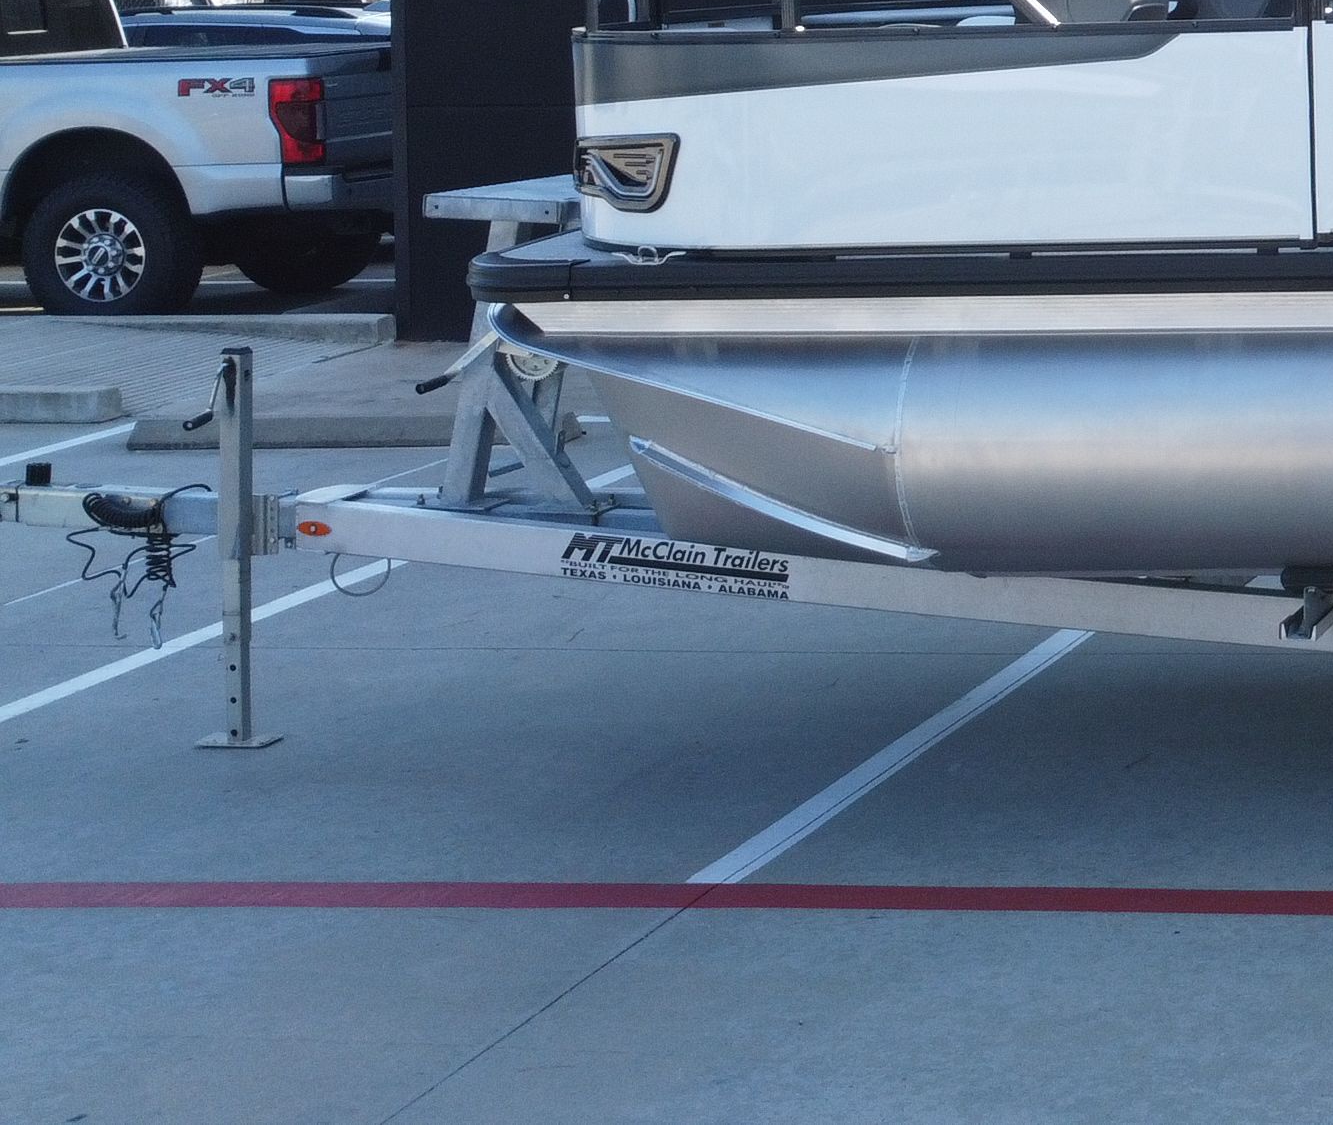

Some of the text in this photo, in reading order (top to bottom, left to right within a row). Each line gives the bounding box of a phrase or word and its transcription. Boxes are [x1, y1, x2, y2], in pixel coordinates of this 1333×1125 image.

[178, 77, 255, 97] FX4
[619, 537, 706, 564] McClain
[713, 547, 789, 573] Trailers
[561, 567, 789, 600] TEXAS LOUISIANA ALABAMA
[610, 565, 638, 573] FOR
[675, 572, 728, 584] LONG
